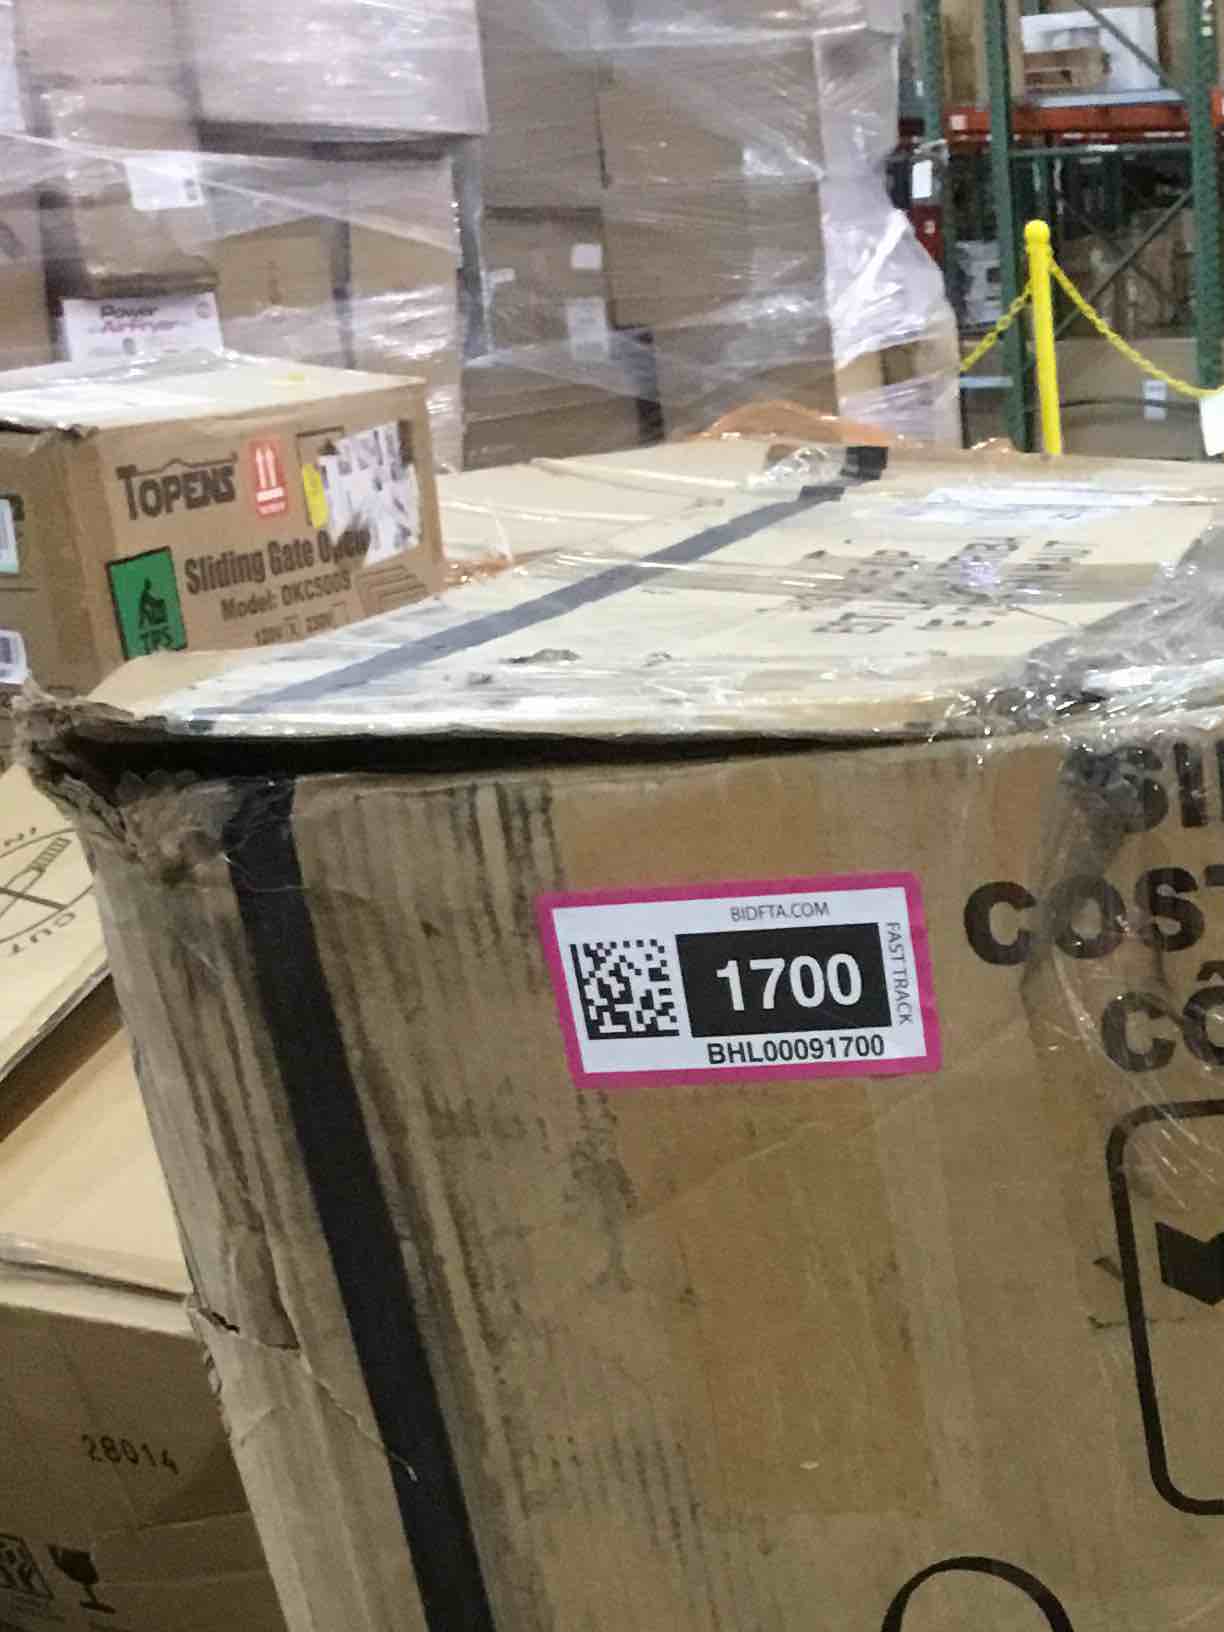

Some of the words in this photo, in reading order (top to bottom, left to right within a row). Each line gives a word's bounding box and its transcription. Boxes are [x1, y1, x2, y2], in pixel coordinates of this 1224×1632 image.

[101, 304, 159, 319] Power
[115, 454, 238, 520] TOPENS
[184, 549, 265, 595] Sliding
[267, 534, 313, 577] Gate
[220, 590, 277, 622] Model:
[730, 901, 830, 922] BIDFTA.COM
[885, 921, 904, 965] FAST
[716, 952, 864, 1012] 1700
[891, 967, 914, 1025] TRACK
[706, 1033, 885, 1065] BHL00091700
